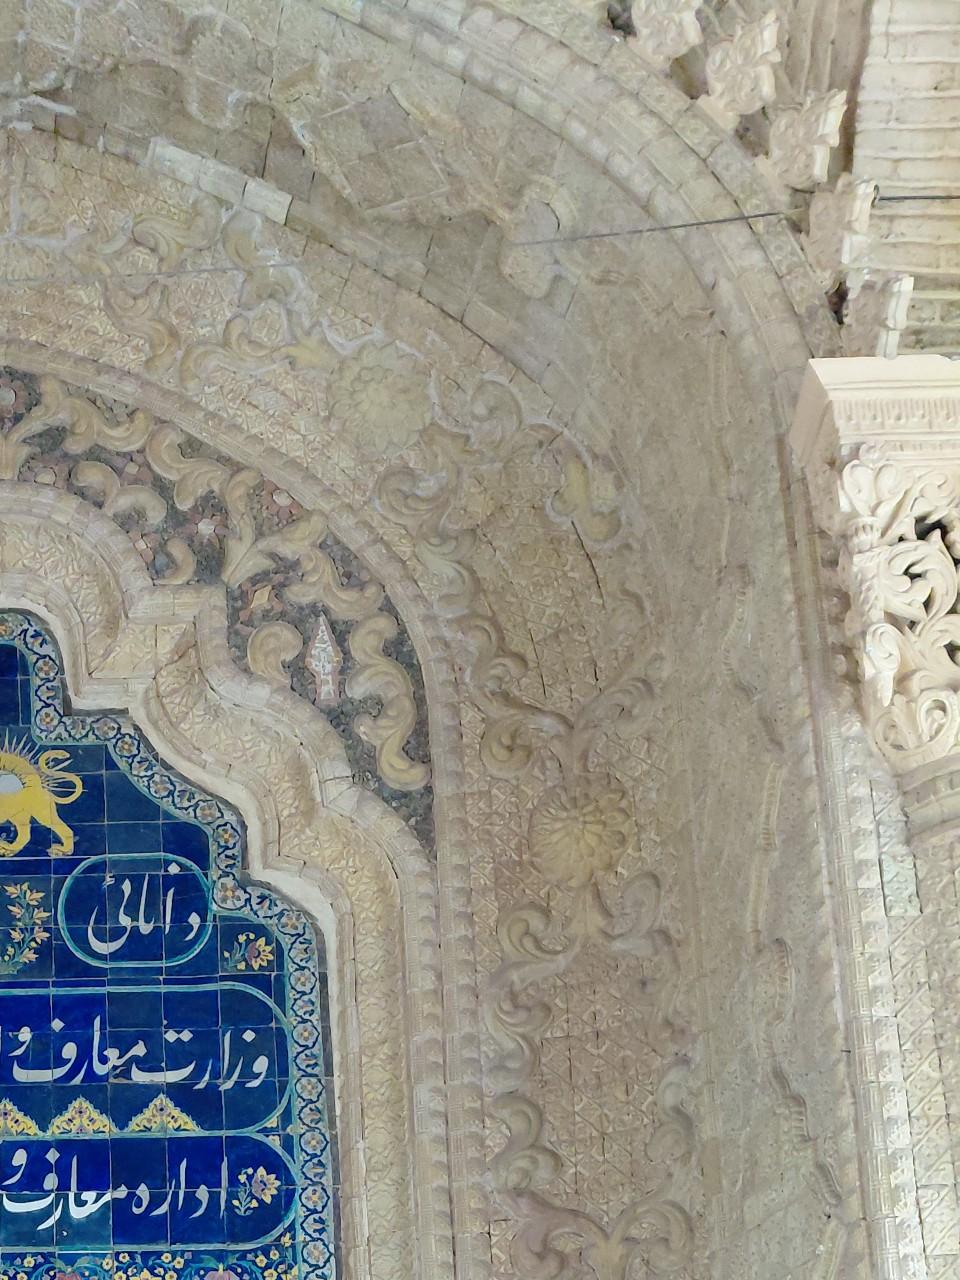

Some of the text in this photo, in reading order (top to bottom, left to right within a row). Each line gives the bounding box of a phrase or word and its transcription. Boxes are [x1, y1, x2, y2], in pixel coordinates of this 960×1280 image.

[12, 1015, 147, 1085] معارف
[130, 1029, 269, 1090] وزارت
[132, 1156, 228, 1219] اداره
